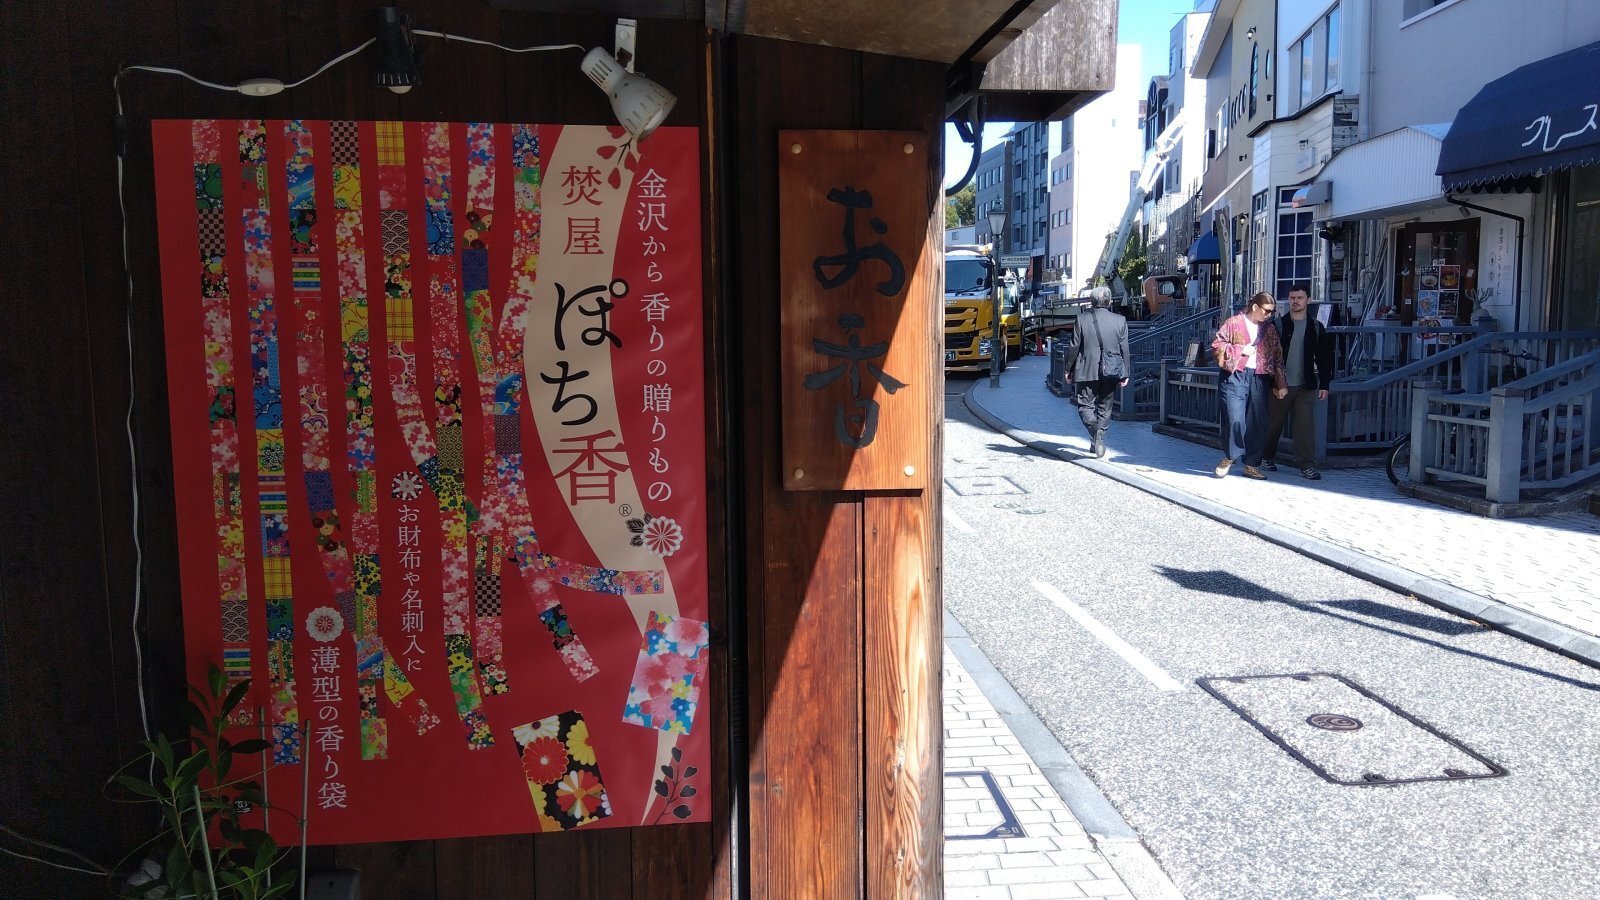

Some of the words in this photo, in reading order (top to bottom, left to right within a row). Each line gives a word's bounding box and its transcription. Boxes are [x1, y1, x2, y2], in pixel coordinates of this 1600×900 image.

[560, 165, 604, 256] 焚屋
[539, 277, 630, 506] ぽち香
[636, 168, 673, 504] 金沢から香りの贈りもの
[803, 186, 910, 450] お香
[397, 504, 426, 672] お財布や名刺入に
[310, 646, 348, 810] 薄型の香り袋
